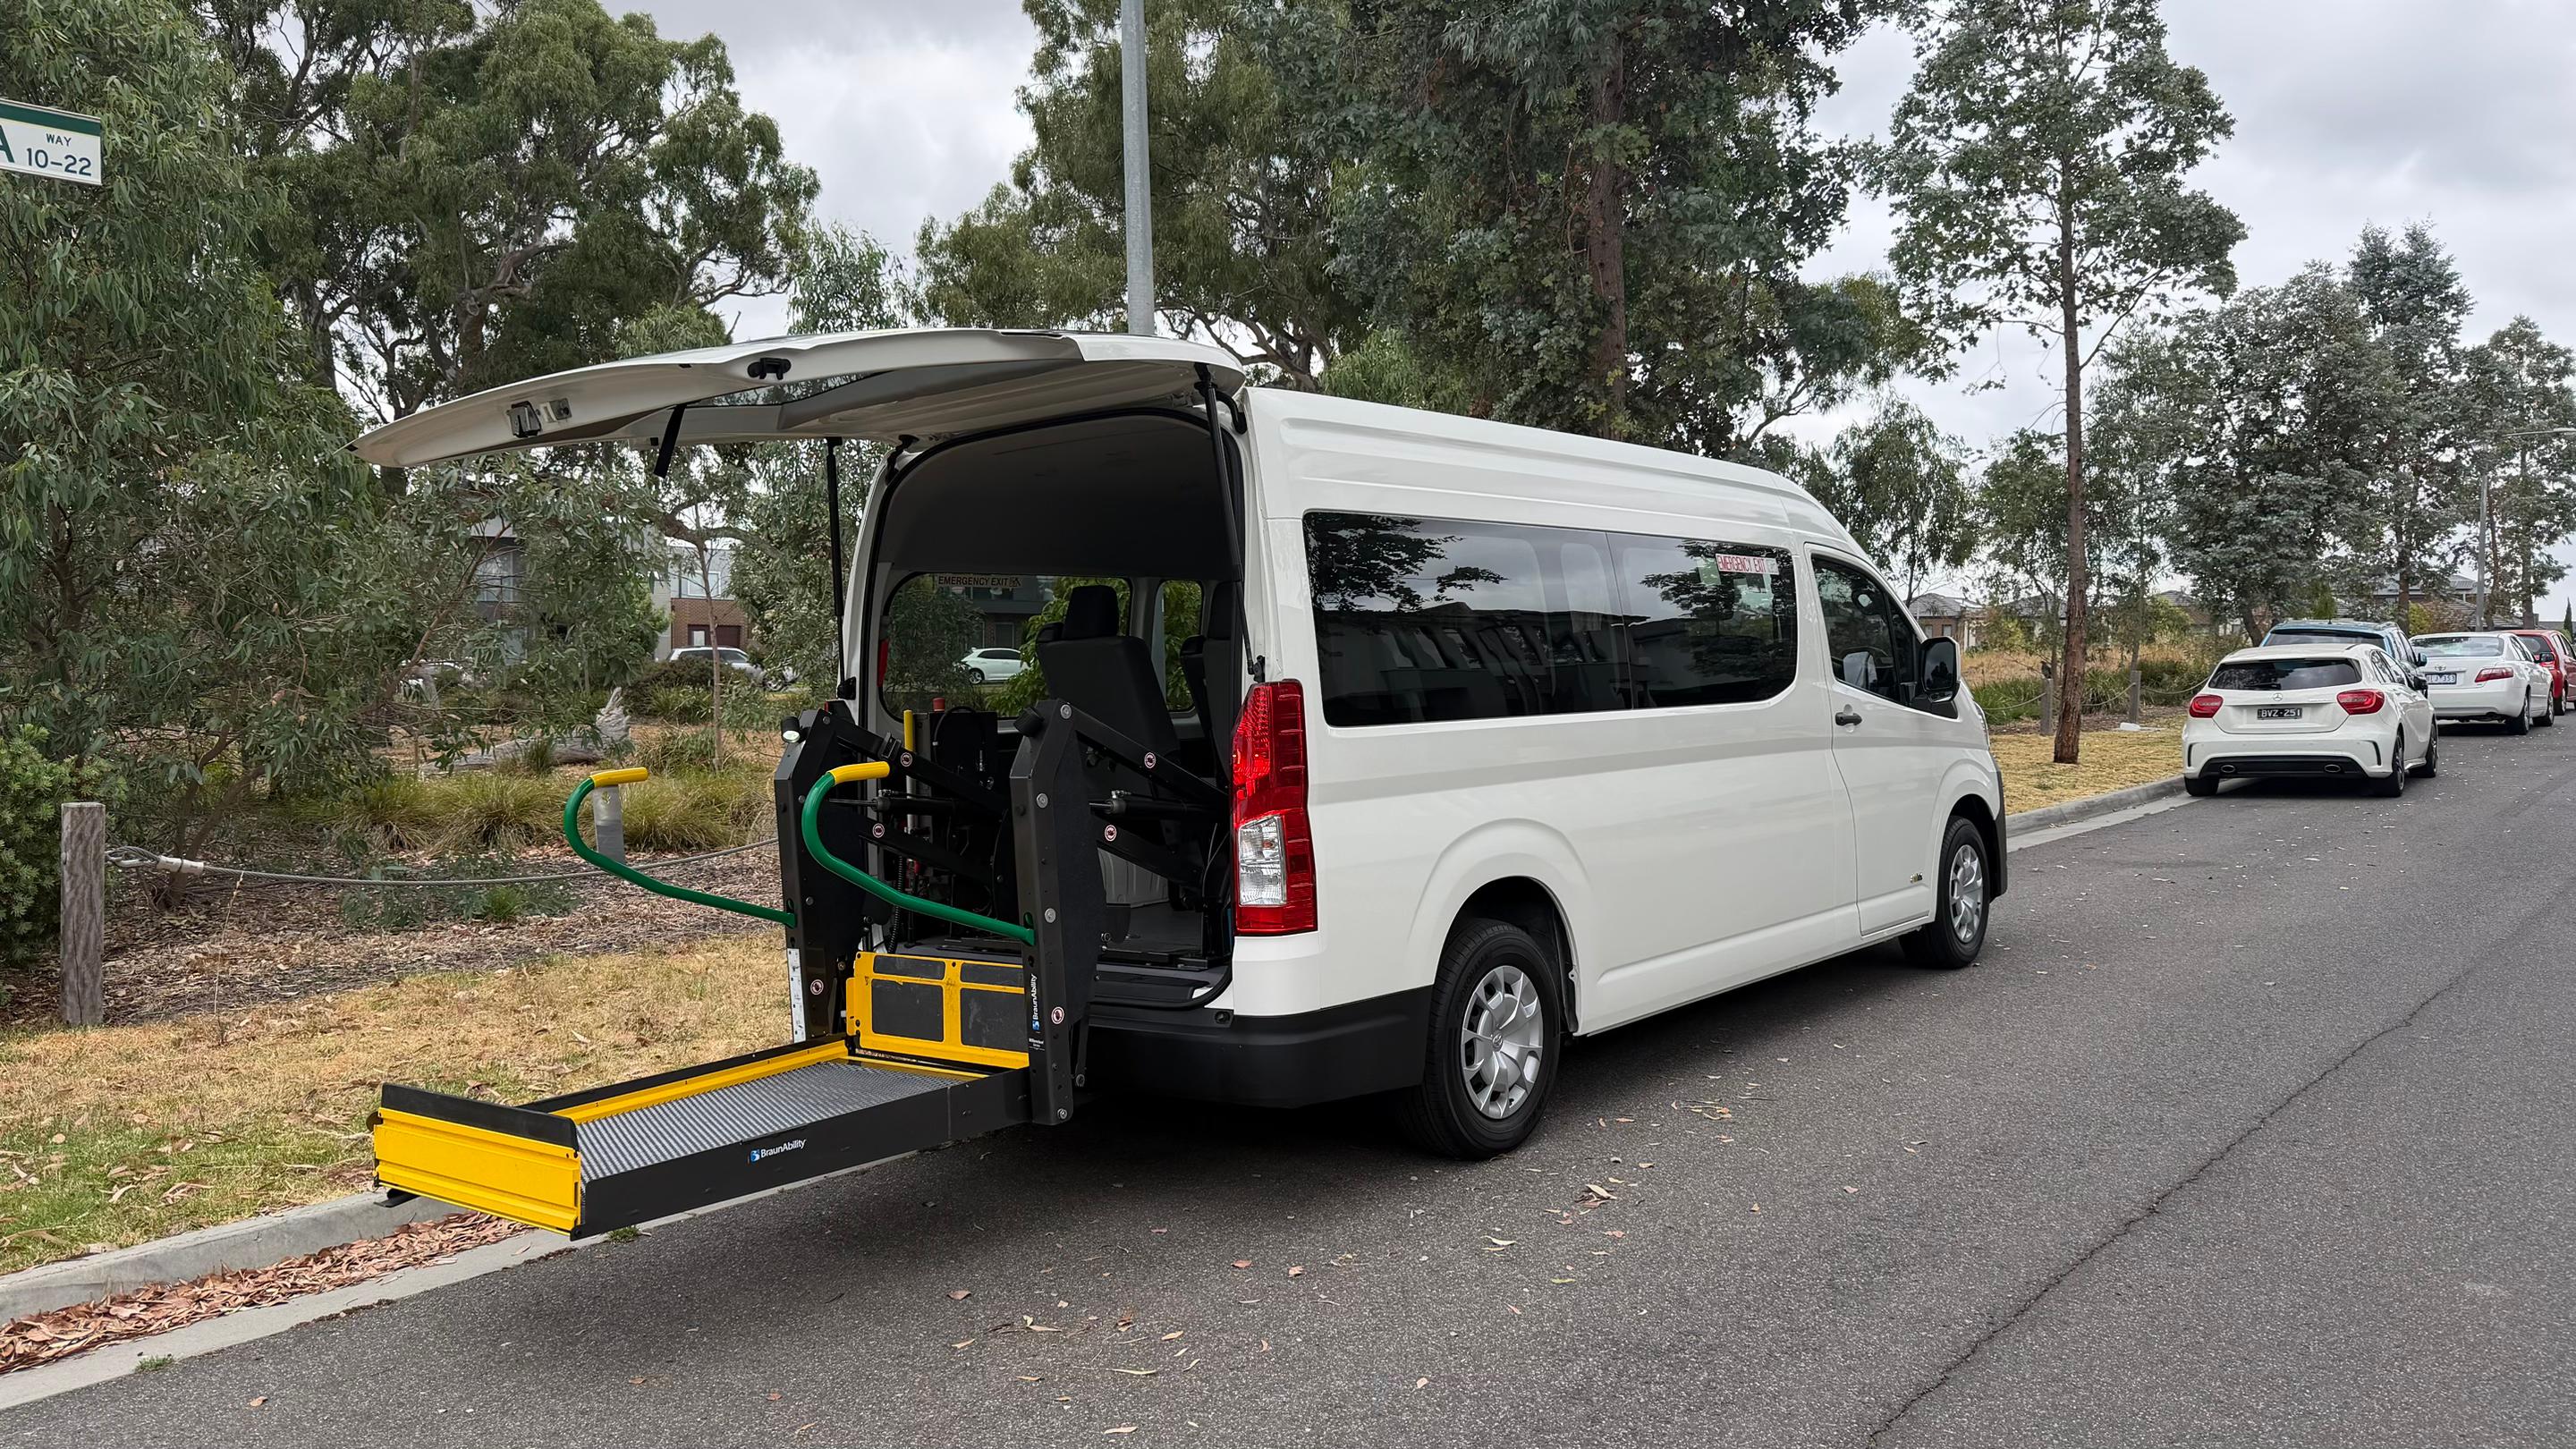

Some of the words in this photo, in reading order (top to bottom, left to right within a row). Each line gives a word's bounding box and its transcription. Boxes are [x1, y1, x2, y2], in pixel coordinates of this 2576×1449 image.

[46, 132, 72, 147] WAY
[26, 148, 92, 177] 10-22
[1716, 555, 1752, 572] EMERGENCY
[1754, 557, 1767, 573] EXIT
[938, 575, 988, 586] EMERGENCY
[991, 577, 1008, 587] EXIT
[1030, 973, 1038, 1020] BraunAbility
[760, 1139, 807, 1158] BraunAbility
